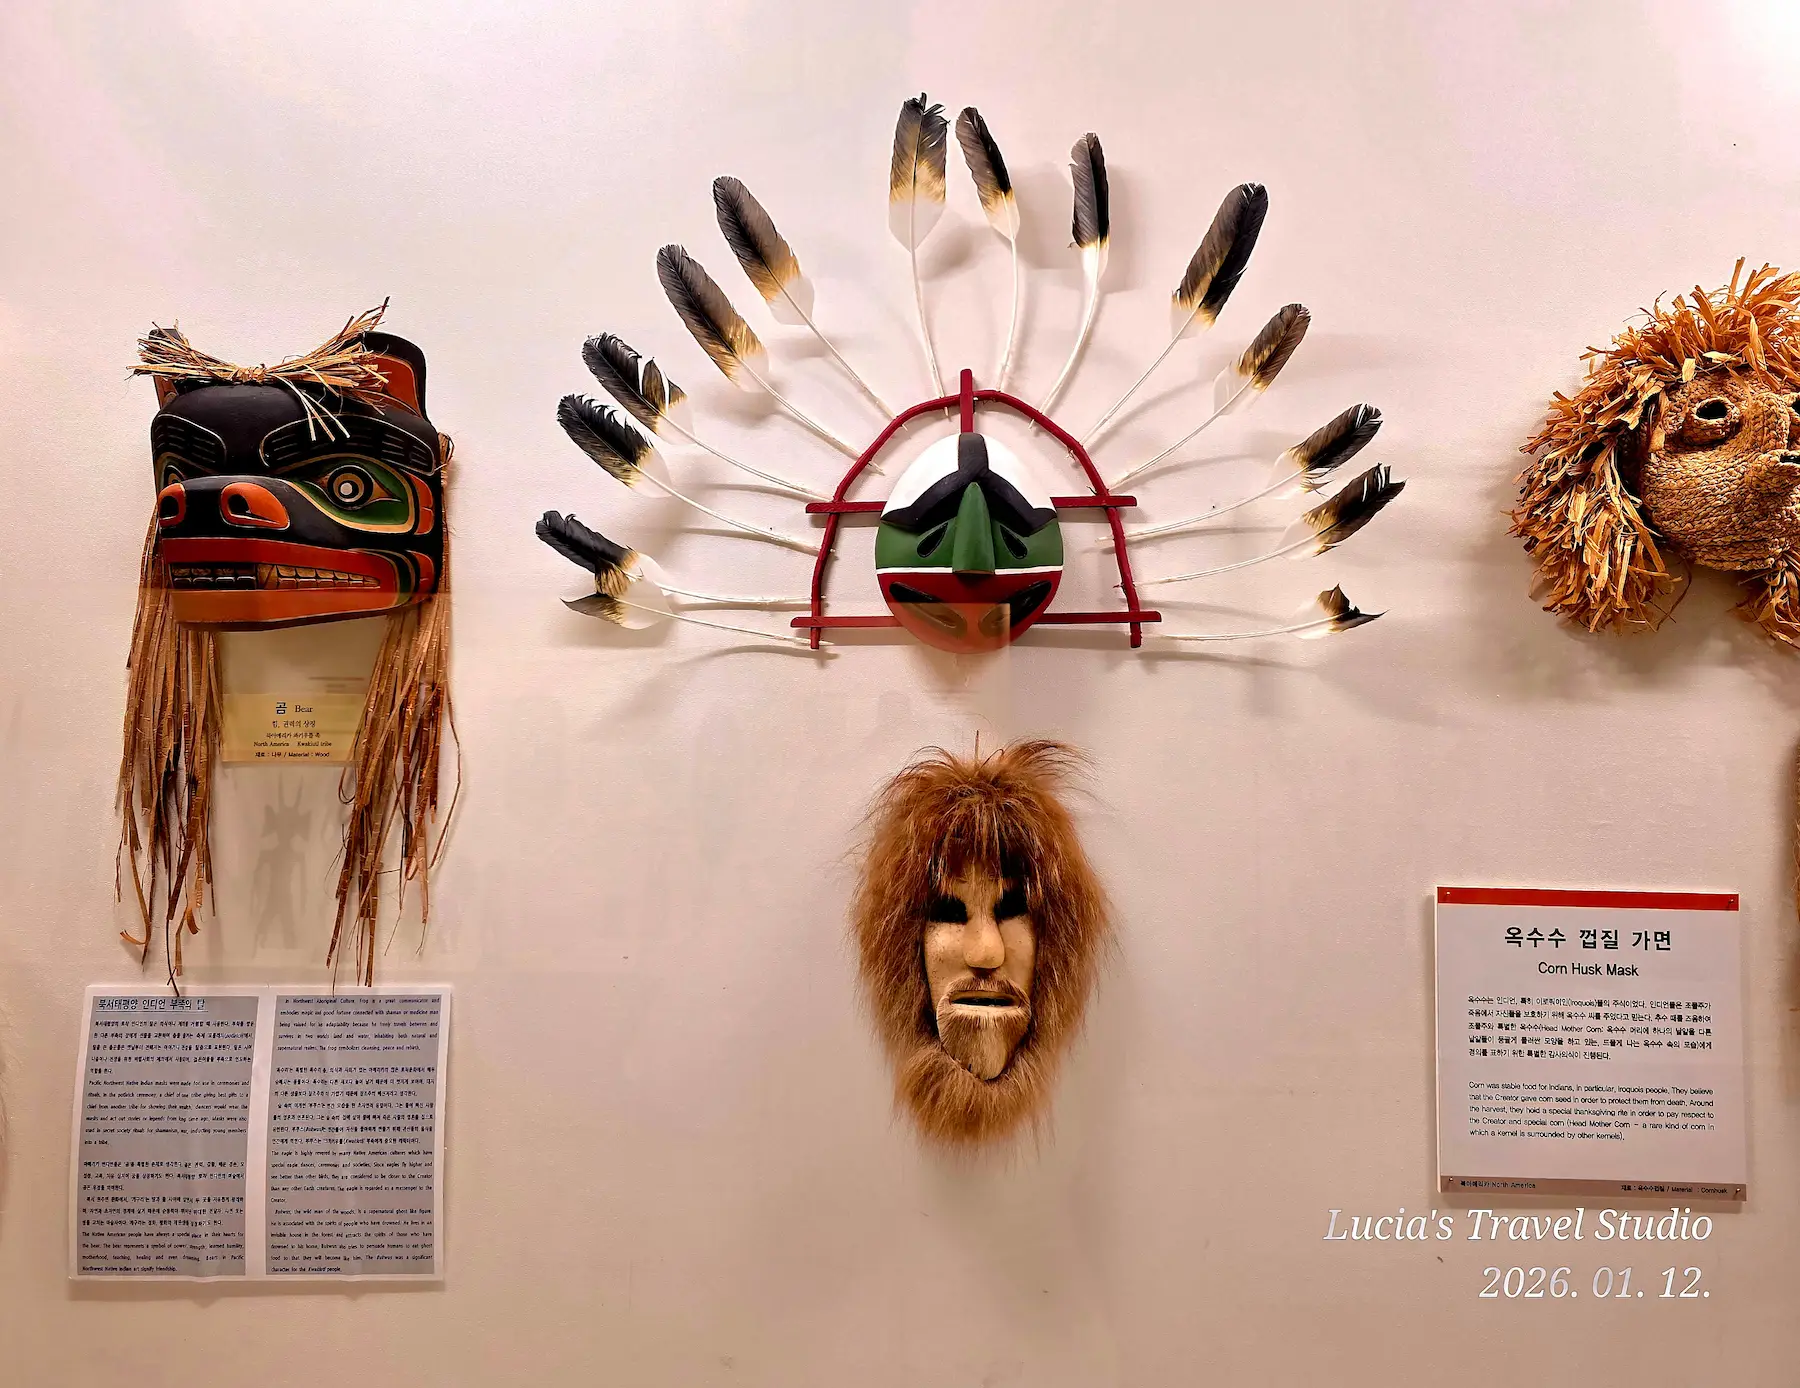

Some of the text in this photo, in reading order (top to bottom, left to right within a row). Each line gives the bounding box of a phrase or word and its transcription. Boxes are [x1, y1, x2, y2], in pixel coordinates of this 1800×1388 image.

[275, 702, 313, 715] 곰 Bear
[1504, 926, 1671, 951] 옥수수 껍질 가면
[1538, 961, 1639, 977] Corn Husk Mask
[1468, 1081, 1485, 1089] Corn
[1522, 1083, 1537, 1091] food
[1538, 1083, 1547, 1091] for
[1583, 1084, 1616, 1094] particular,
[1617, 1085, 1644, 1094] Iroquois
[1671, 1086, 1688, 1096] They
[1689, 1087, 1713, 1096] believe
[1494, 1093, 1519, 1102] Creator
[1520, 1095, 1537, 1103] gave
[1608, 1097, 1631, 1105] protect
[1632, 1097, 1649, 1105] them
[1650, 1098, 1665, 1106] from
[1689, 1099, 1714, 1107] Around
[1481, 1105, 1508, 1114] harvest,
[1509, 1106, 1524, 1115] they
[1525, 1106, 1540, 1114] hold
[1548, 1107, 1572, 1116] special
[1573, 1108, 1616, 1117] thanksgiving
[1617, 1108, 1628, 1117] rite
[1666, 1111, 1679, 1119] pay
[1469, 1117, 1480, 1125] the
[1482, 1116, 1506, 1125] Creator
[1508, 1118, 1522, 1126] and
[1523, 1118, 1547, 1127] special
[1566, 1118, 1587, 1128] (Head
[1589, 1120, 1612, 1128] Mother
[1614, 1120, 1631, 1129] Corn
[1665, 1122, 1680, 1130] kind
[1681, 1122, 1689, 1130] of
[1469, 1128, 1489, 1136] which
[1497, 1129, 1518, 1137] kernel
[1527, 1131, 1565, 1139] surrounded
[1566, 1131, 1576, 1140] by
[1577, 1132, 1595, 1140] other
